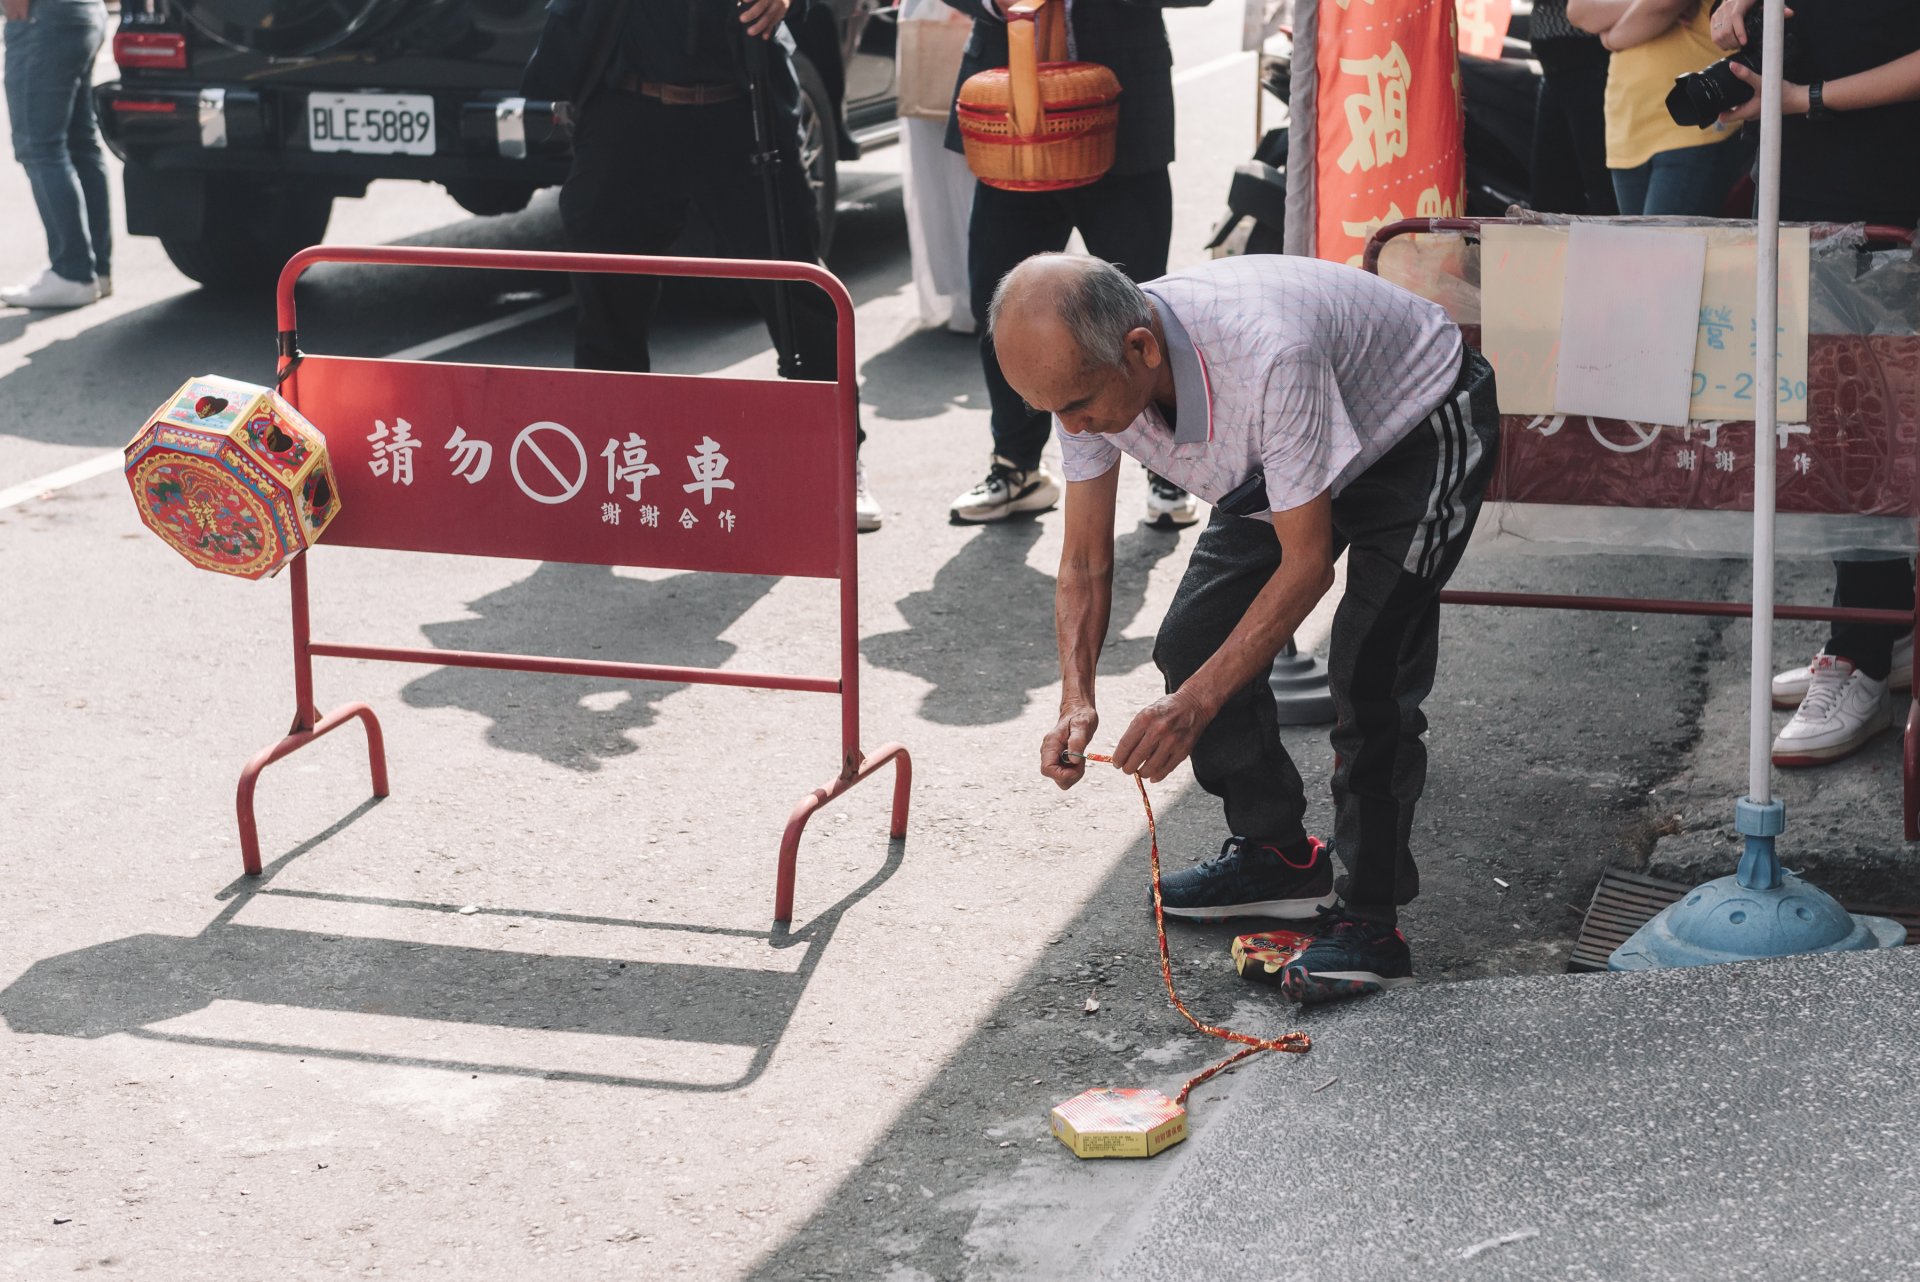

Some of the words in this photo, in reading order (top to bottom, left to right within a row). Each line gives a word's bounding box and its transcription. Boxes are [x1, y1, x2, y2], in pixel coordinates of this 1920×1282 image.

[1677, 450, 1812, 475] 謝謝作
[601, 502, 736, 532] 謝謝合作
